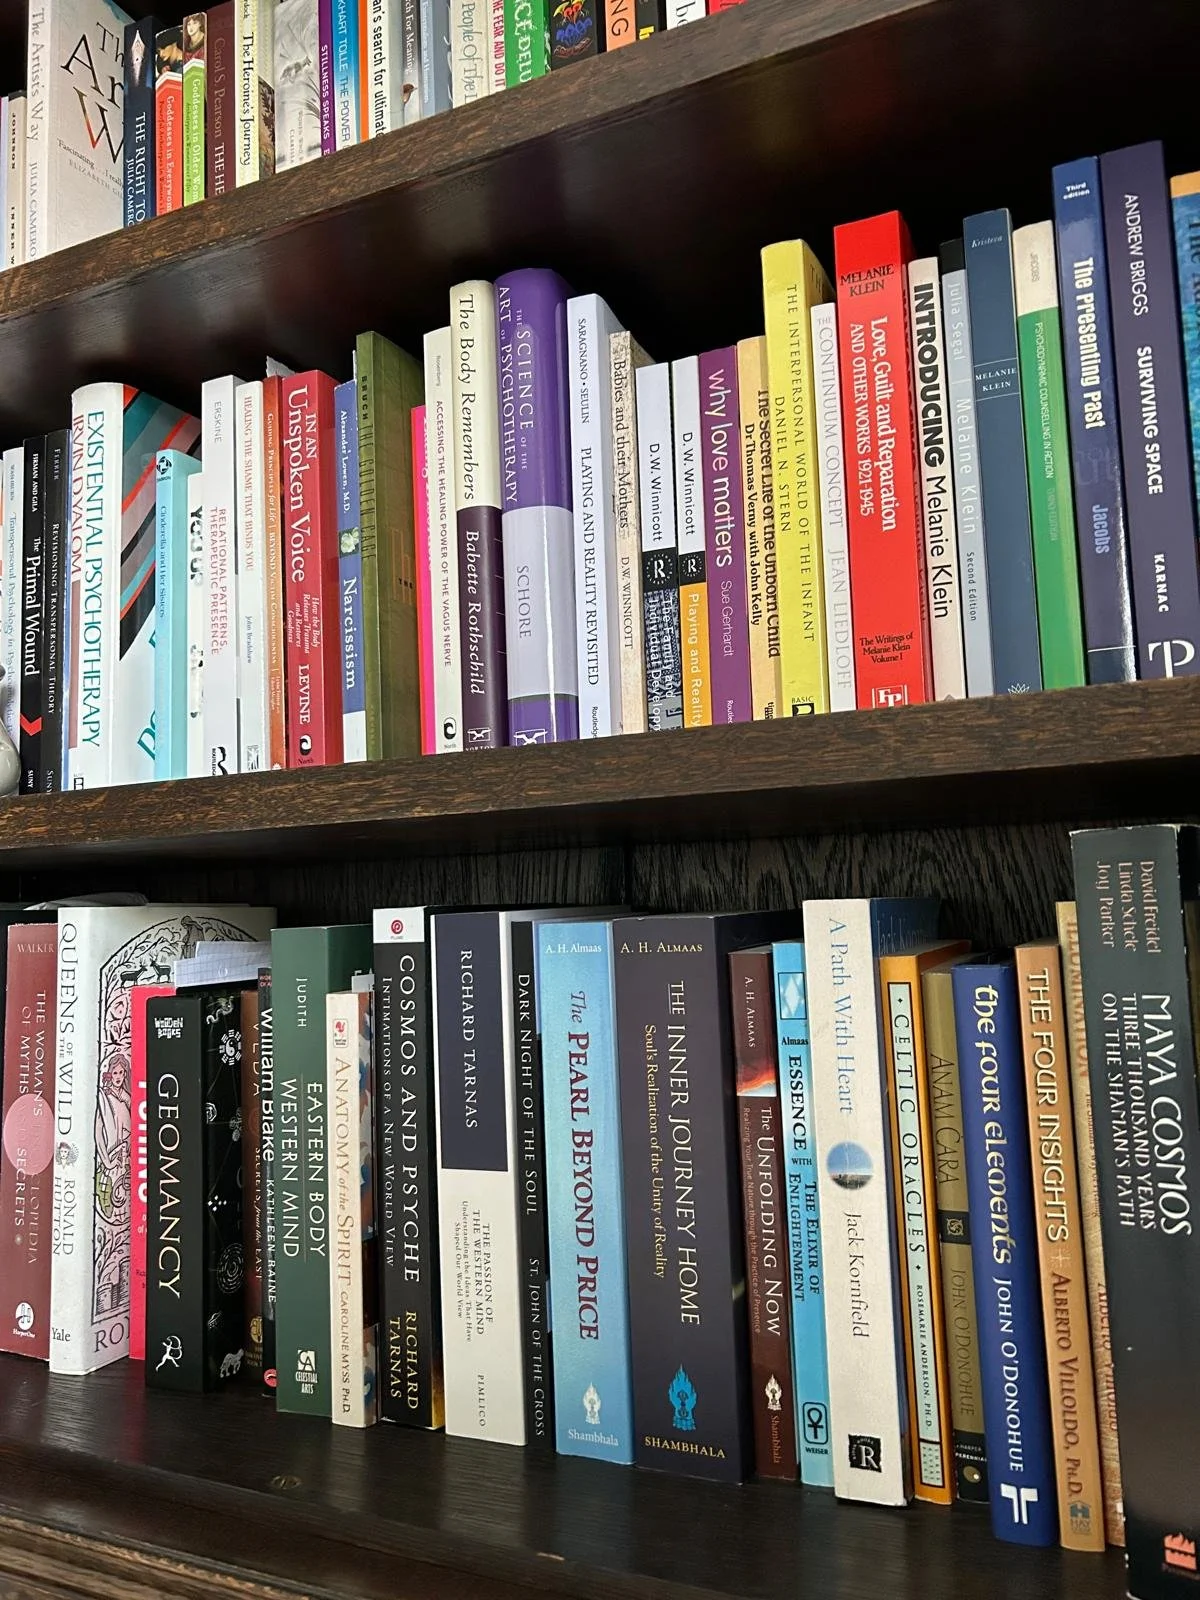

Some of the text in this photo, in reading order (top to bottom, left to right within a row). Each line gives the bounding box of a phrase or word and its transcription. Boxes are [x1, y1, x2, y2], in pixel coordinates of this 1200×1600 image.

[27, 8, 45, 141] The Artist's Way
[240, 32, 255, 166] The Heroine's Journey
[320, 44, 330, 140] STILLNESS SPEAKS
[493, 15, 506, 87] FEAR AND DO IT
[135, 112, 147, 143] THE
[135, 148, 147, 196] RIGHT
[498, 286, 511, 322] ART
[840, 264, 896, 287] MELANIE
[849, 280, 885, 297] KLEIN
[457, 294, 479, 500] The Body Remembers
[516, 330, 533, 429] SCIENCE
[1074, 257, 1106, 429] The Presenting Past
[437, 400, 445, 454] ACCESSING
[501, 346, 518, 503] PSYCHOTHERAPY
[870, 316, 899, 531] Love, Guilt and Reparation
[913, 283, 953, 619] INTRODUCING Melanie Klein
[1124, 194, 1170, 612] ANDREW BRIGGS SURVIVING SPACE KARNAC
[283, 385, 311, 583] Unspoken Voice
[438, 478, 446, 521] HEALING
[704, 369, 736, 567] why love matters
[774, 396, 791, 532] DANIEL N. STERN
[786, 284, 814, 642] THE INTERPERSONAL WORLD OF THE INFANT
[961, 485, 979, 534] Klein
[82, 410, 104, 747] EXISTENTIAL PSYCHOTHERAPY
[439, 523, 448, 558] POWER
[440, 560, 448, 574] OF
[441, 577, 449, 596] THE
[580, 447, 599, 685] PLAYING AND REALITY REVISITED
[966, 551, 976, 584] Second
[1092, 504, 1111, 554] Jacobs
[23, 537, 42, 677] The Primal Wound
[343, 576, 358, 690] Narcissism
[442, 599, 450, 632] VAGUS
[443, 634, 451, 666] NERVE
[466, 530, 485, 694] Babette Rothschild
[516, 565, 531, 638] SCHORE
[720, 580, 734, 657] Sue Gerhardt
[968, 588, 978, 622] Edition
[298, 664, 311, 725] LEVINE
[1095, 860, 1115, 948] Joy Parker
[1119, 862, 1138, 952] Linda Schele
[1140, 860, 1161, 953] David Freidel
[57, 923, 79, 1135] QUEENS WILD
[295, 978, 307, 1028] JUDITH
[460, 949, 478, 1128] RICHARD TARNAS
[829, 918, 861, 1114] A Path With Heart
[973, 985, 999, 1034] the
[399, 954, 420, 1282] COSMOS AND PSYCHE
[788, 1055, 807, 1151] ESSENCE
[894, 1015, 915, 1112] CELTIC
[1028, 968, 1069, 1241] THE FOUR INSIGHTS
[1102, 993, 1135, 1226] ON THE SHAMAN'S PATH
[1120, 992, 1156, 1230] THREE THOUSAND YEARS
[1142, 994, 1192, 1236] MAYA COSMOS
[157, 1073, 181, 1300] GEOMANCY
[281, 1079, 299, 1257] WESTERN MIND
[307, 1082, 325, 1257] EASTERN BODY
[568, 991, 599, 1340] The PEARL BEYOND PRICE
[645, 1024, 668, 1278] Soul's Realization of the Unity of Reality
[668, 980, 700, 1325] THE INNER JOURNEY HOME
[902, 1133, 925, 1252] ORACLES
[985, 1121, 1016, 1264] elements
[265, 1179, 277, 1303] KATHLEEN RAINE
[335, 1057, 355, 1384] ANATOMY of the SPIRIT CAROLINE MYSS
[843, 1212, 869, 1338] Jack Kornfield
[389, 1316, 402, 1398] TARNAS
[405, 1310, 419, 1409] RICHARD
[917, 1284, 927, 1340] ROSEMARIE
[1052, 1272, 1072, 1351] ALBERTO
[992, 1277, 1024, 1473] JOHN O'DONOHUE
[644, 1436, 726, 1459] SHAMBHALA
